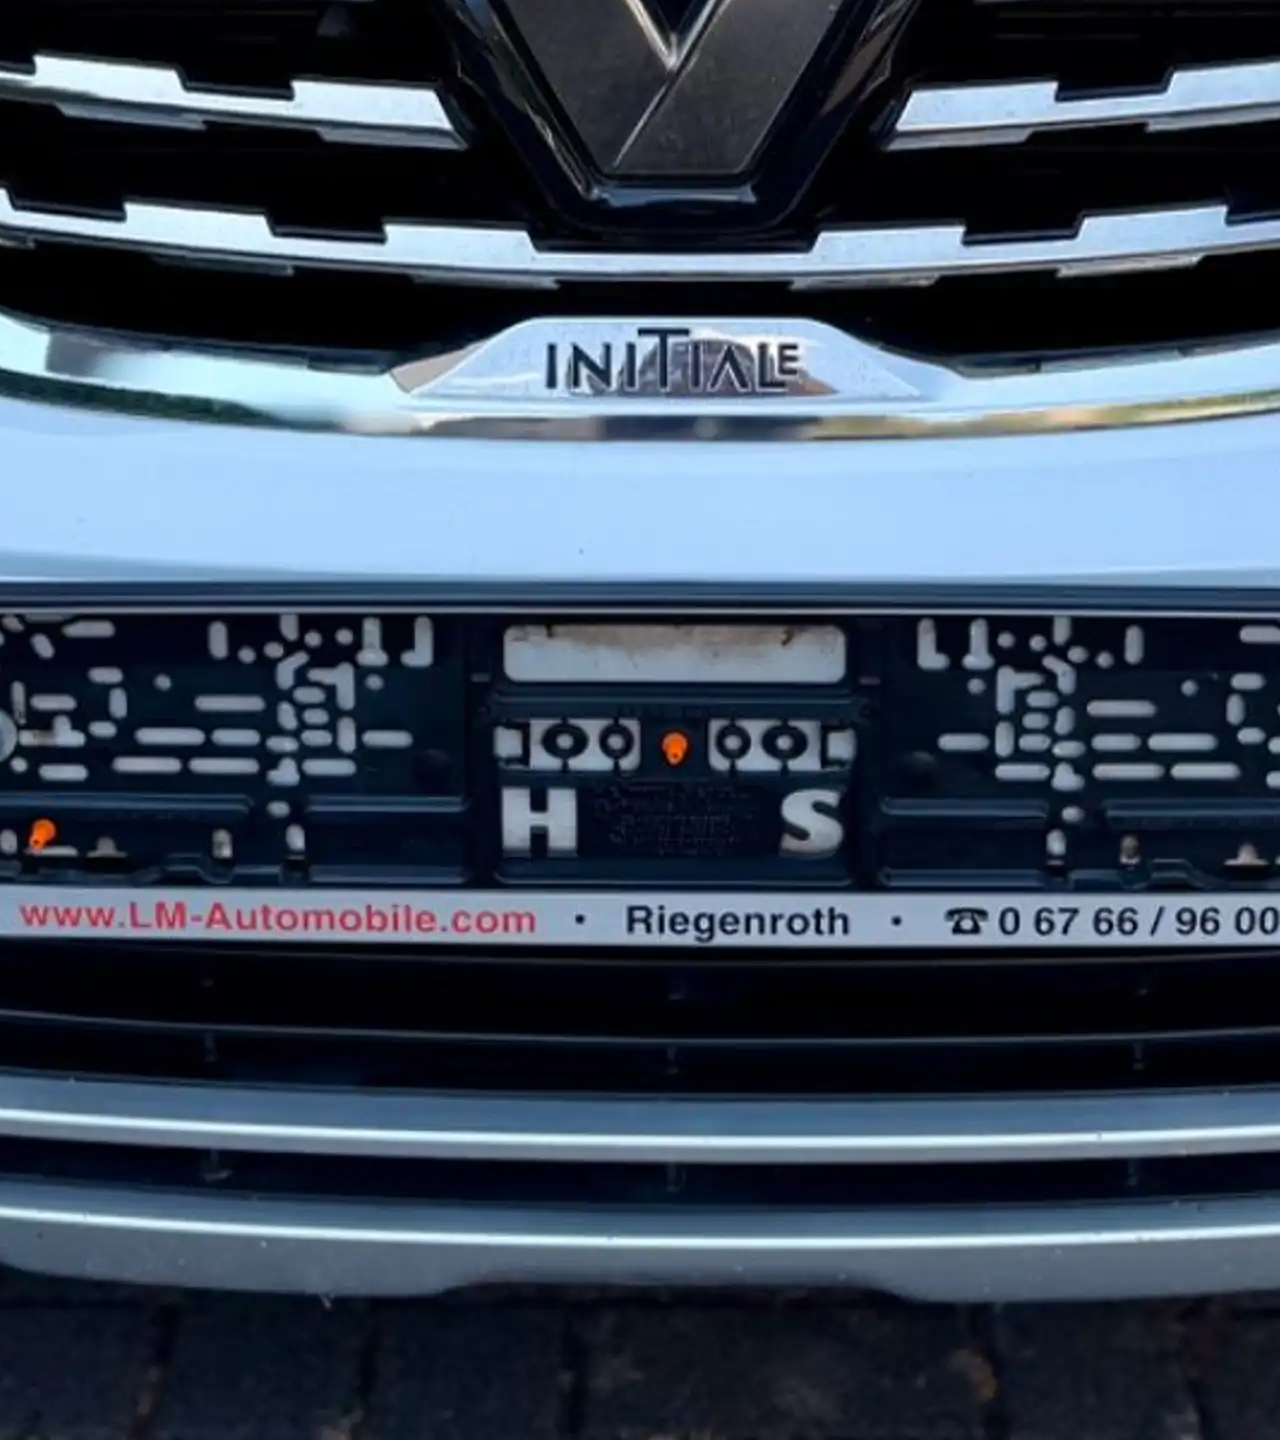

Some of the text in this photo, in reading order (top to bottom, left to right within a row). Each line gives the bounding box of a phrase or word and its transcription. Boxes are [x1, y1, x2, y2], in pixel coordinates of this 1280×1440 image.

[545, 327, 801, 393] INITIALE
[19, 900, 537, 935] www.LM-Automobile.com
[625, 904, 851, 944] Riegenroth
[998, 906, 1022, 937] 0
[1032, 906, 1081, 937] 67
[1091, 906, 1140, 937] 66
[1174, 906, 1221, 937] 96
[1233, 905, 1280, 936] 00
